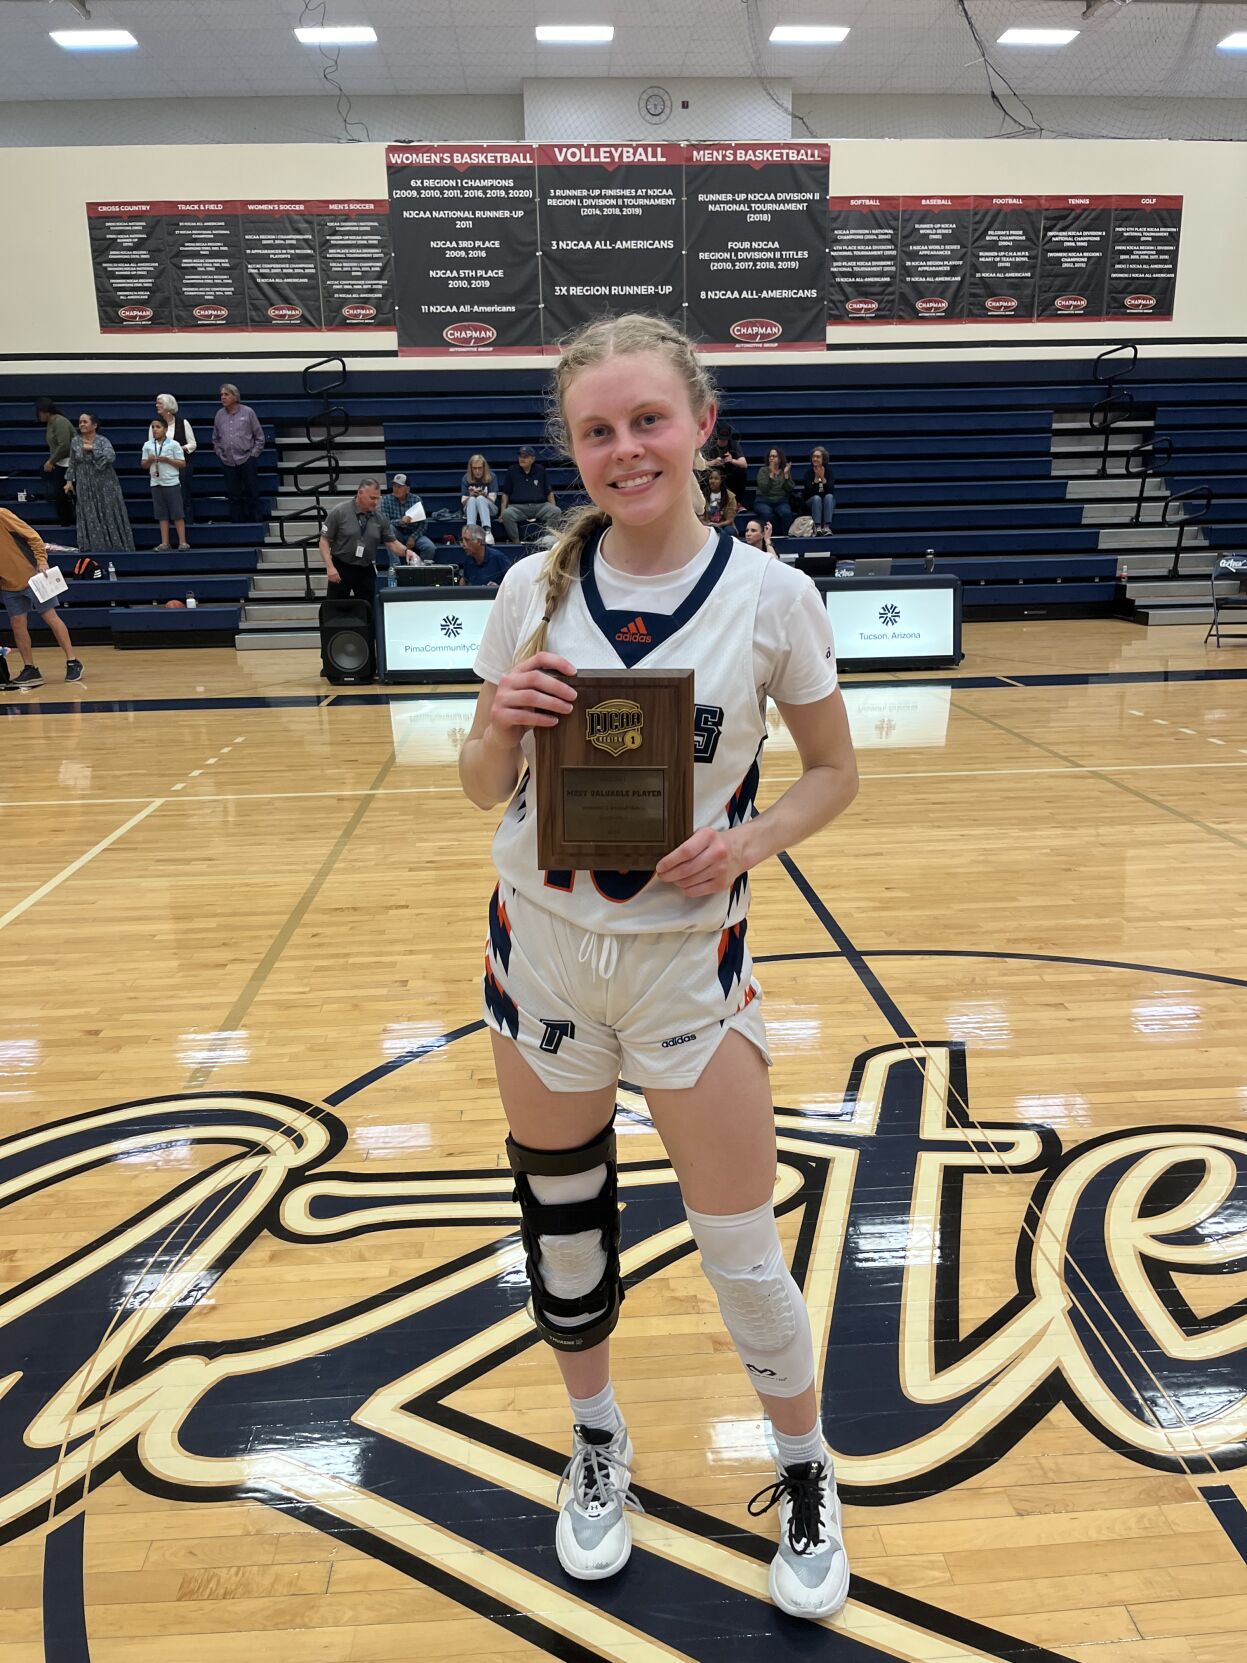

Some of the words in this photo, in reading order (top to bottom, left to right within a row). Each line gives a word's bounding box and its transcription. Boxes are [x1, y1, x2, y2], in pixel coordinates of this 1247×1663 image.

[390, 154, 450, 163] WOMEN'S
[454, 153, 533, 163] BASKETBALL
[554, 148, 666, 162] VOLLEYBALL
[693, 150, 733, 161] MEN'S
[737, 150, 821, 160] BASKETBALL
[393, 190, 419, 198] (2009,
[420, 190, 442, 198] 2010,
[444, 190, 462, 198] 2011,
[464, 190, 485, 198] 2016,
[486, 190, 507, 198] 2019,
[509, 189, 532, 198] 2020)
[751, 203, 808, 211] TOURNAMENT
[476, 210, 524, 218] RUNNER-UP
[747, 214, 771, 222] (2018)
[552, 241, 557, 249] 3
[559, 241, 592, 249] NJCAA
[594, 240, 674, 249] ALL-AMERICANS
[448, 280, 470, 288] 2010,
[555, 287, 567, 295] 3X
[570, 286, 609, 295] REGION
[612, 286, 672, 294] RUNNER-UP
[700, 291, 706, 299] 8
[708, 290, 739, 298] NJCAA
[741, 290, 817, 298] ALL-AMERICANS
[448, 330, 492, 338] CHAPMAN
[616, 632, 652, 643] adidas
[860, 632, 890, 640] Tucson,
[588, 711, 641, 736] NJCAA
[661, 1033, 696, 1048] adidas
